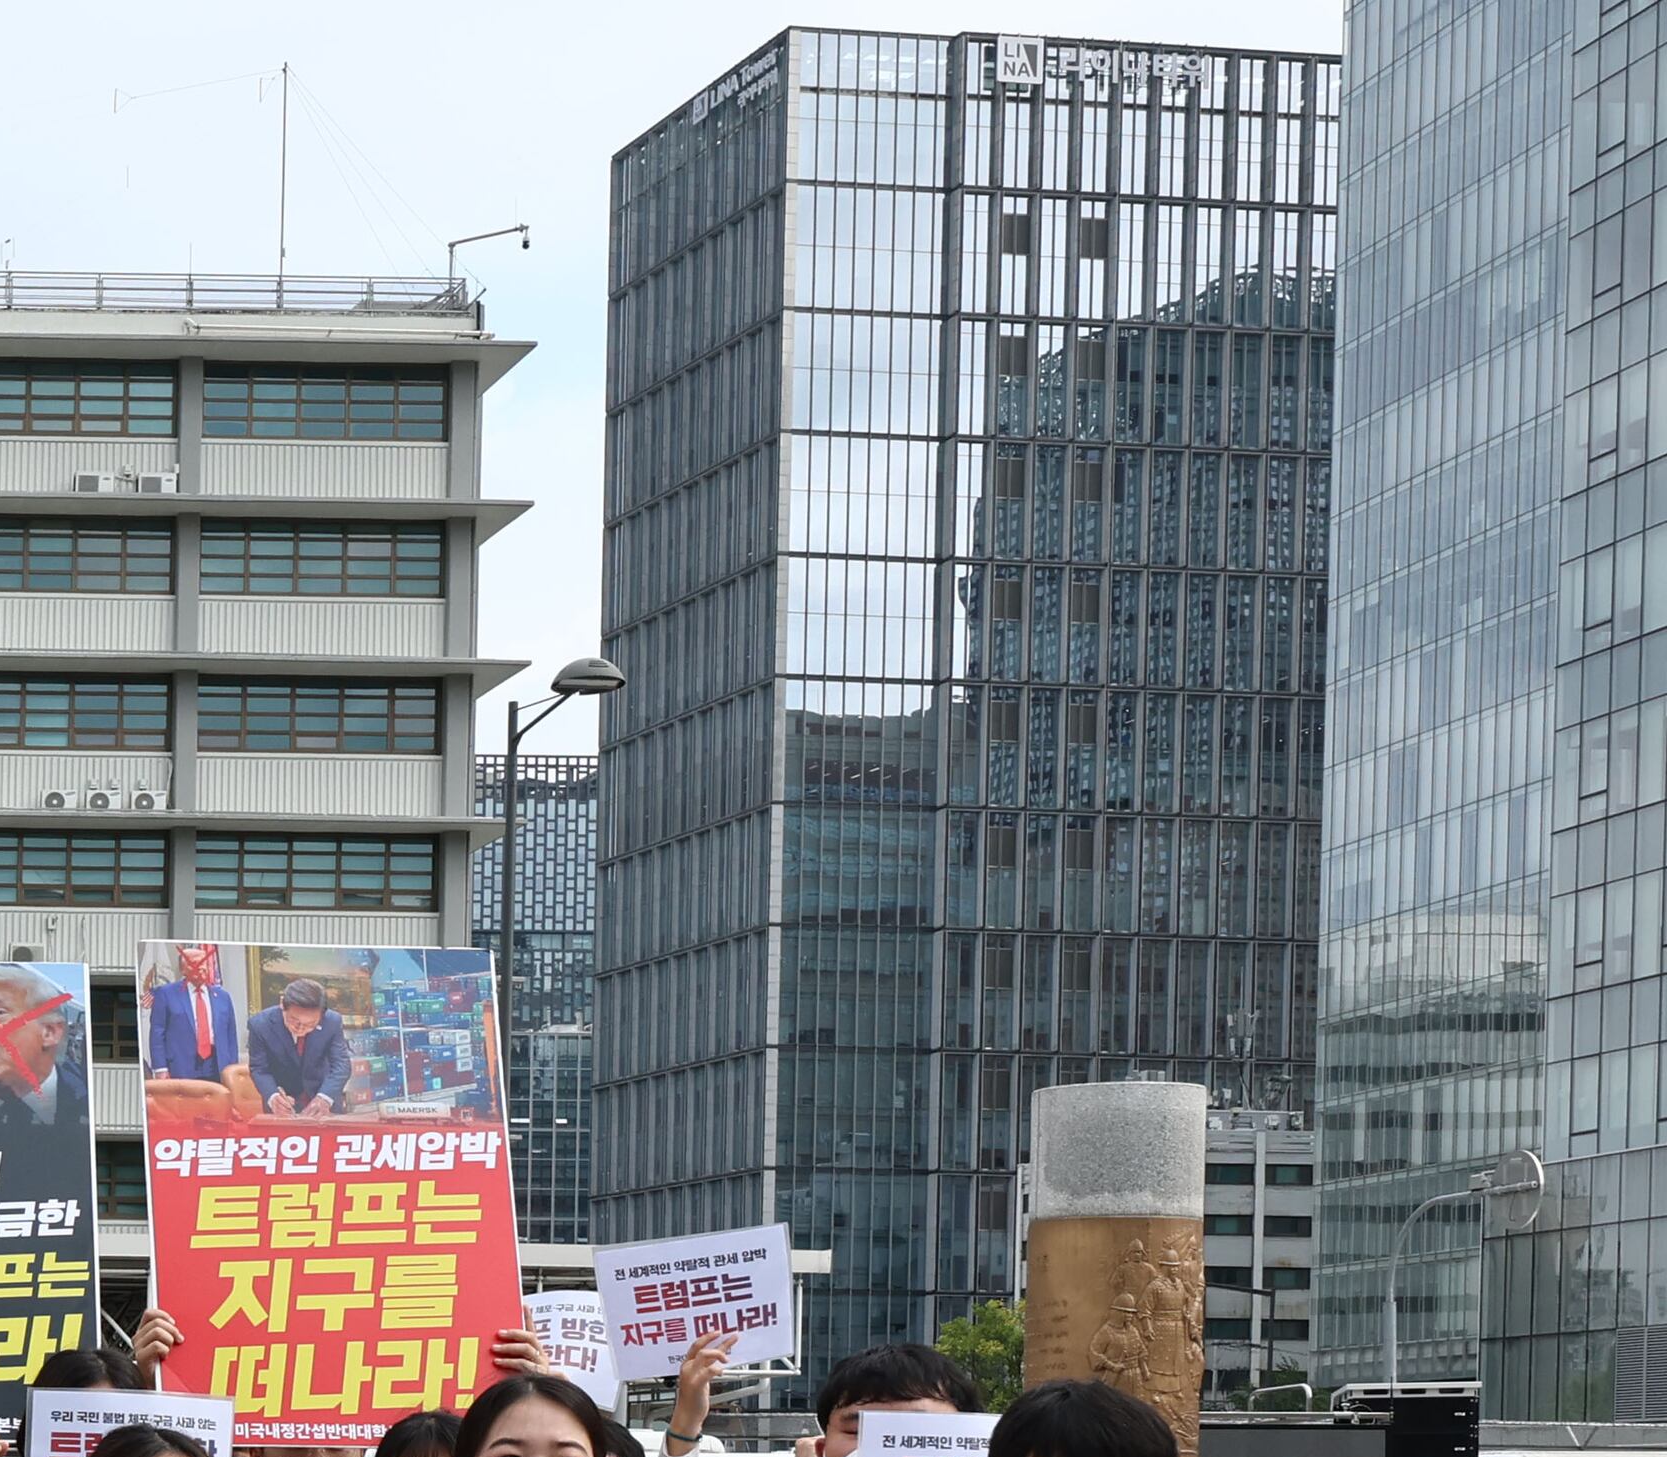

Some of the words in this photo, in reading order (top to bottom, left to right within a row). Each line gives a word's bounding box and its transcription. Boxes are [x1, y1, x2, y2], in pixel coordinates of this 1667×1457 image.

[1059, 48, 1212, 89] 라이나타워
[710, 75, 739, 109] LINA
[154, 1135, 319, 1177] 약탈적인
[190, 1180, 482, 1249] 트럼프는
[615, 1267, 626, 1281] 전
[629, 1260, 671, 1280] 세계적인
[675, 1255, 709, 1275] 약탈적
[712, 1251, 739, 1269] 관세
[742, 1247, 767, 1265] 압박
[209, 1254, 459, 1332] 지구를
[633, 1273, 754, 1315] 트럼프는
[622, 1312, 687, 1348] 지구를
[692, 1302, 778, 1342] 떠나라!
[209, 1337, 480, 1417] 떠나라!
